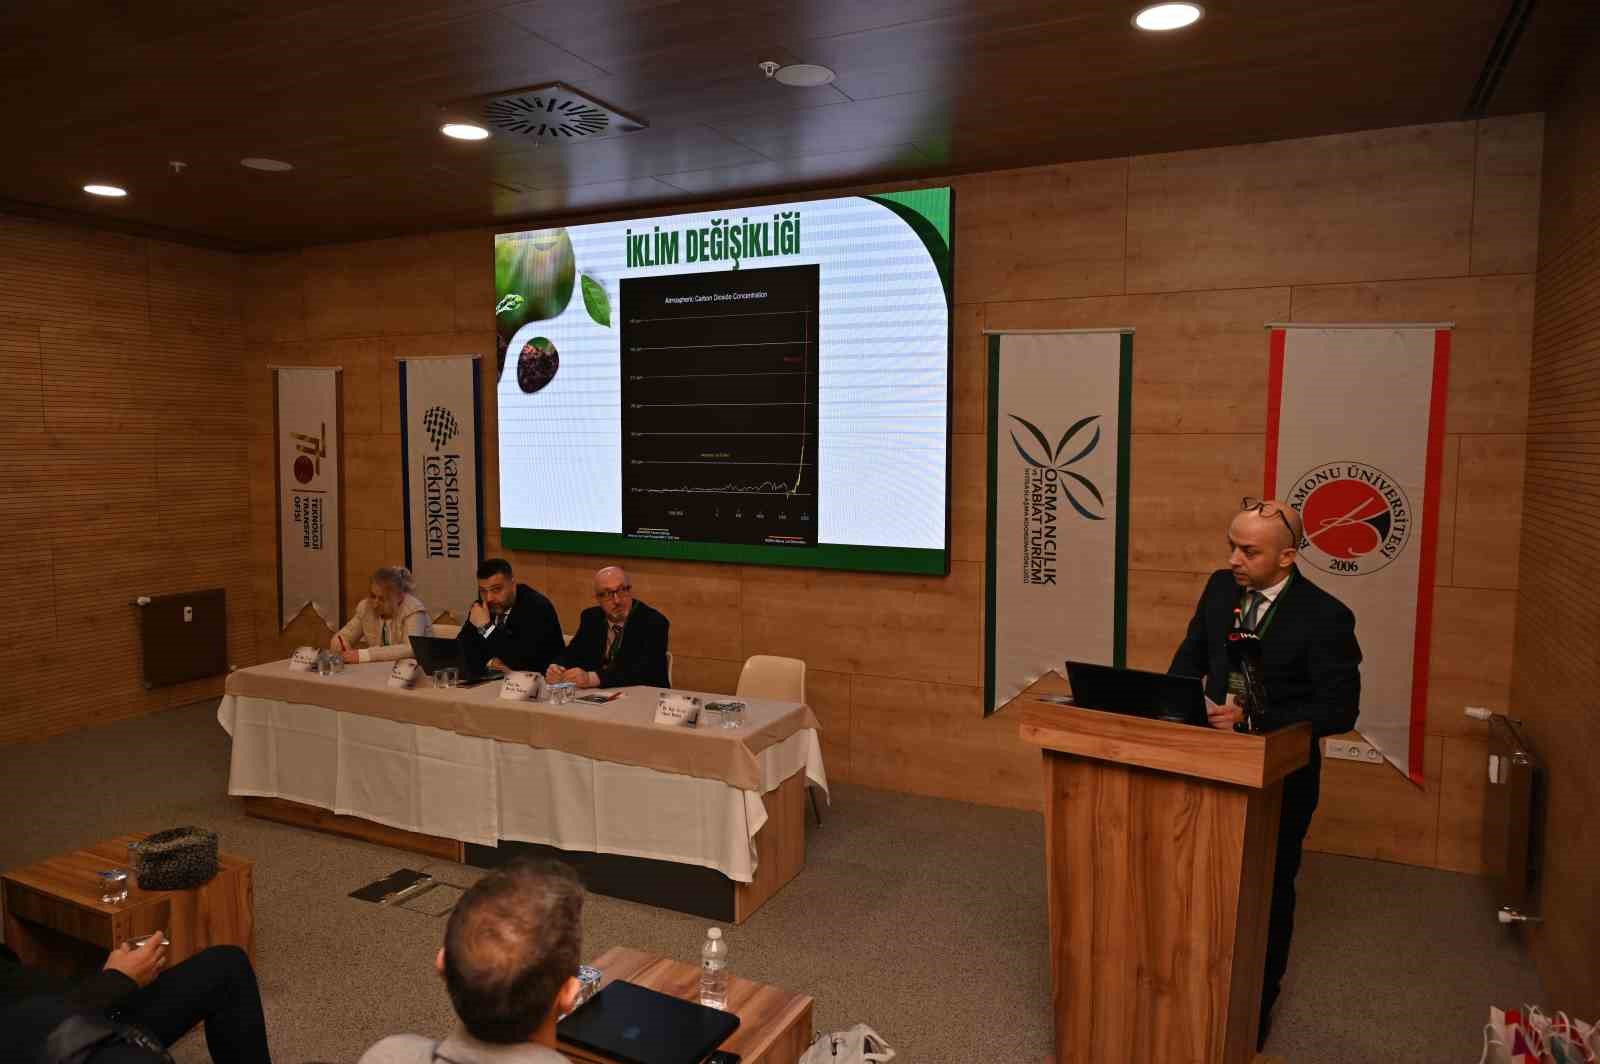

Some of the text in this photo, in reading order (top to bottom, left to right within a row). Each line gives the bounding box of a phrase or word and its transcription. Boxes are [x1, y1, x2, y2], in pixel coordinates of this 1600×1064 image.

[626, 212, 801, 271] İKLİM DEĞİŞİKLİĞİ
[428, 456, 444, 558] teknokent
[444, 455, 461, 558] kastamonu
[1031, 477, 1043, 525] TABİAT
[1044, 469, 1058, 585] ORMANCILIK
[1347, 464, 1409, 560] ÜNİVERSİTESİ
[1031, 528, 1043, 585] TURİZMİ
[1328, 559, 1359, 572] 2006
